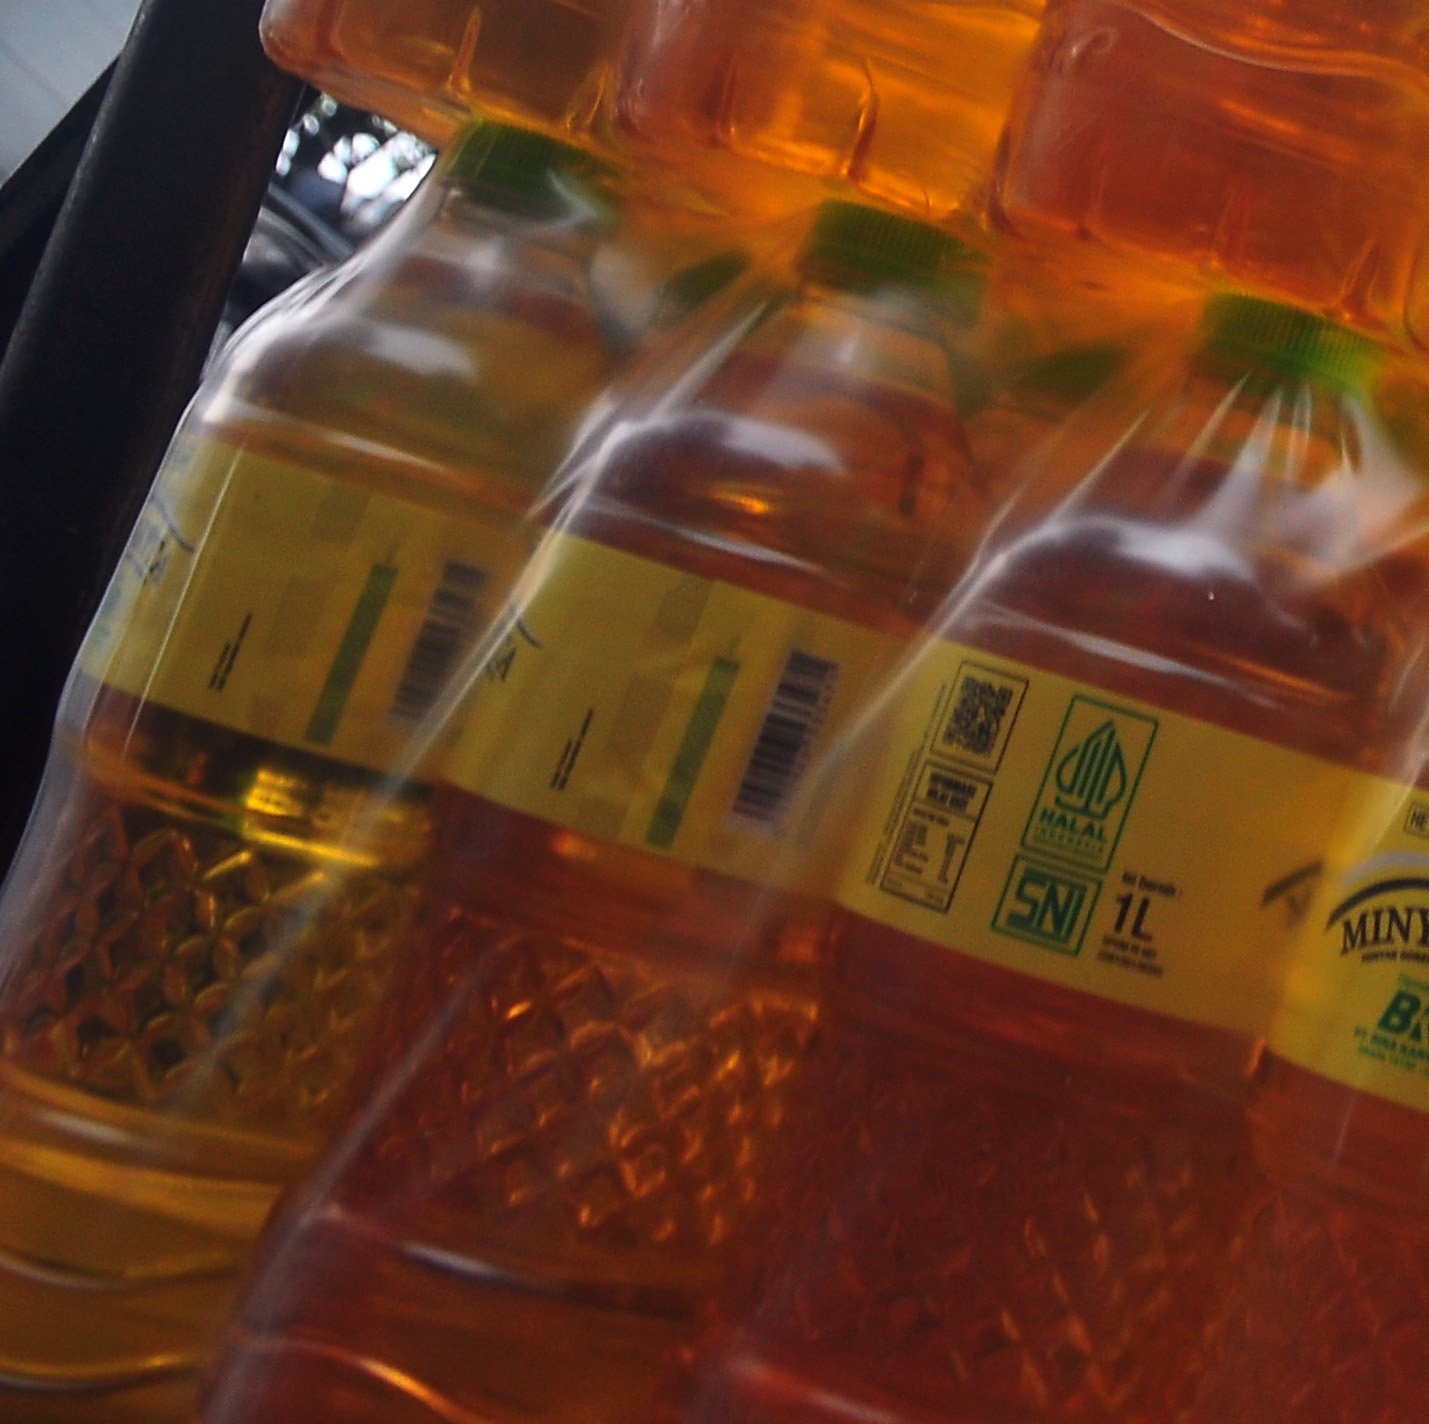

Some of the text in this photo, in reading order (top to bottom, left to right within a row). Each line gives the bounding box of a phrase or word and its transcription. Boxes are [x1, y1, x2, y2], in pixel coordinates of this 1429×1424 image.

[1039, 806, 1107, 844] HALAL
[1006, 867, 1087, 945] SNI
[1115, 892, 1153, 942] 1L
